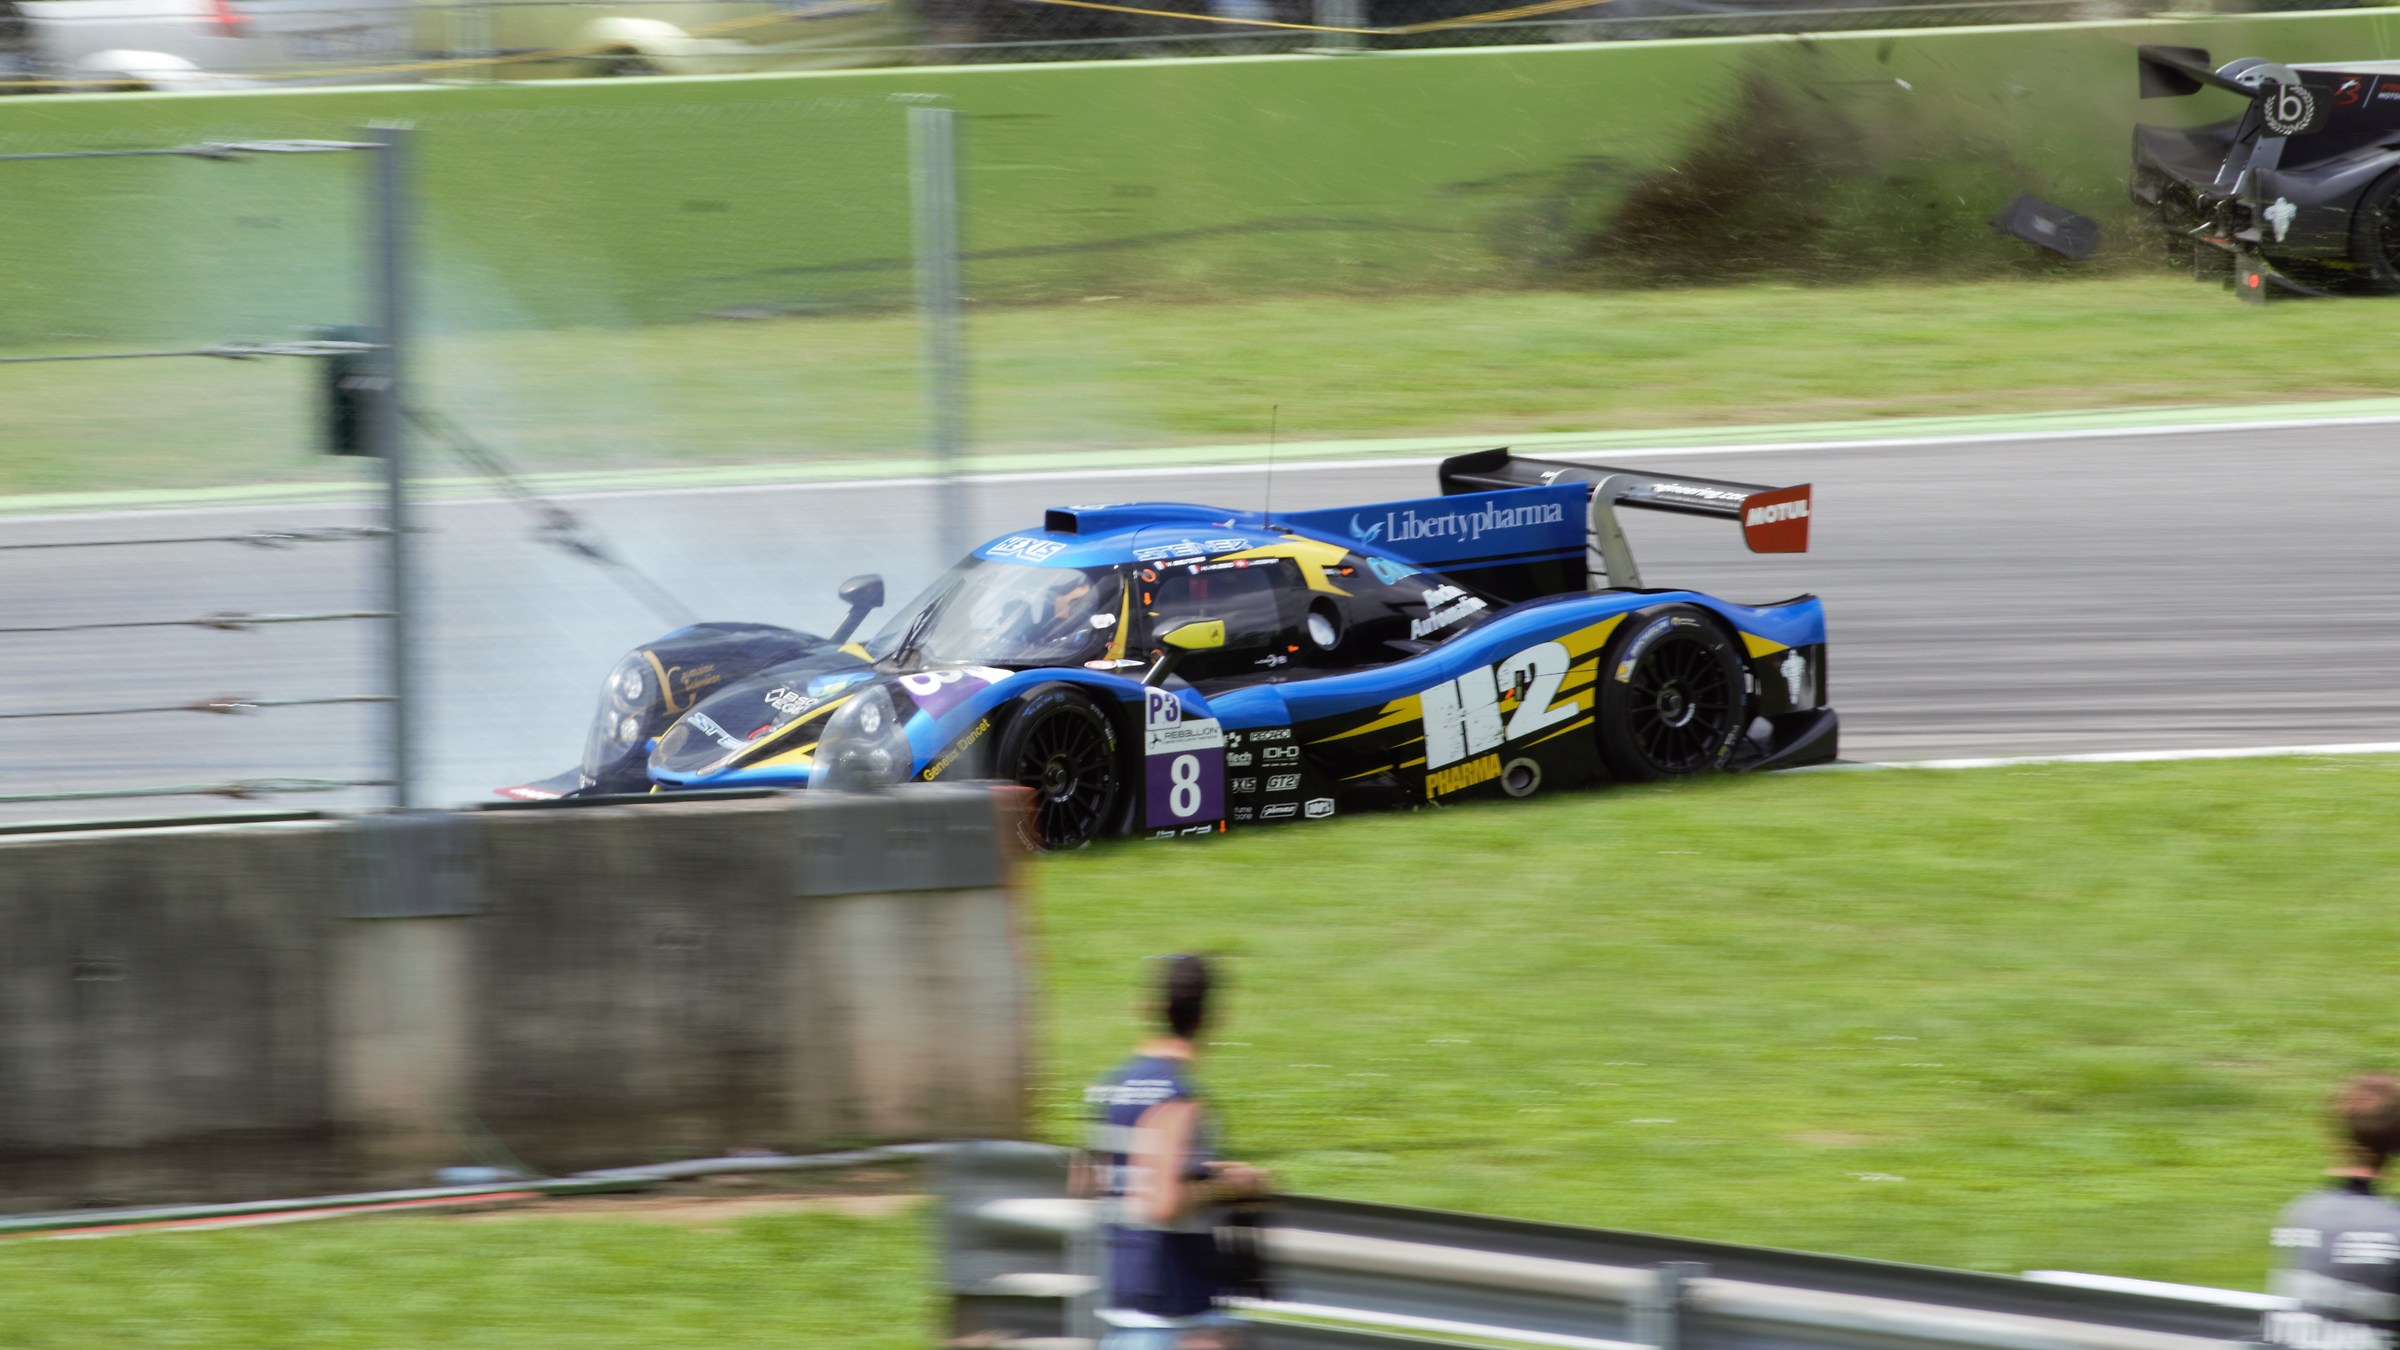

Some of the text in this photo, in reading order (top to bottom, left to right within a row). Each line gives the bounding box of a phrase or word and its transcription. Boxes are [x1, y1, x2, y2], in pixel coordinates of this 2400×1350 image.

[1386, 500, 1564, 543] Libertypharma
[1747, 499, 1809, 527] MOTUL
[994, 536, 1066, 560] HEXIS
[1150, 693, 1179, 724] P3
[1420, 641, 1580, 771] H2
[923, 717, 991, 781] Geneux Dancet
[1164, 726, 1219, 740] REBELLION
[1169, 753, 1202, 818] 8
[1425, 753, 1503, 800] PHARMA
